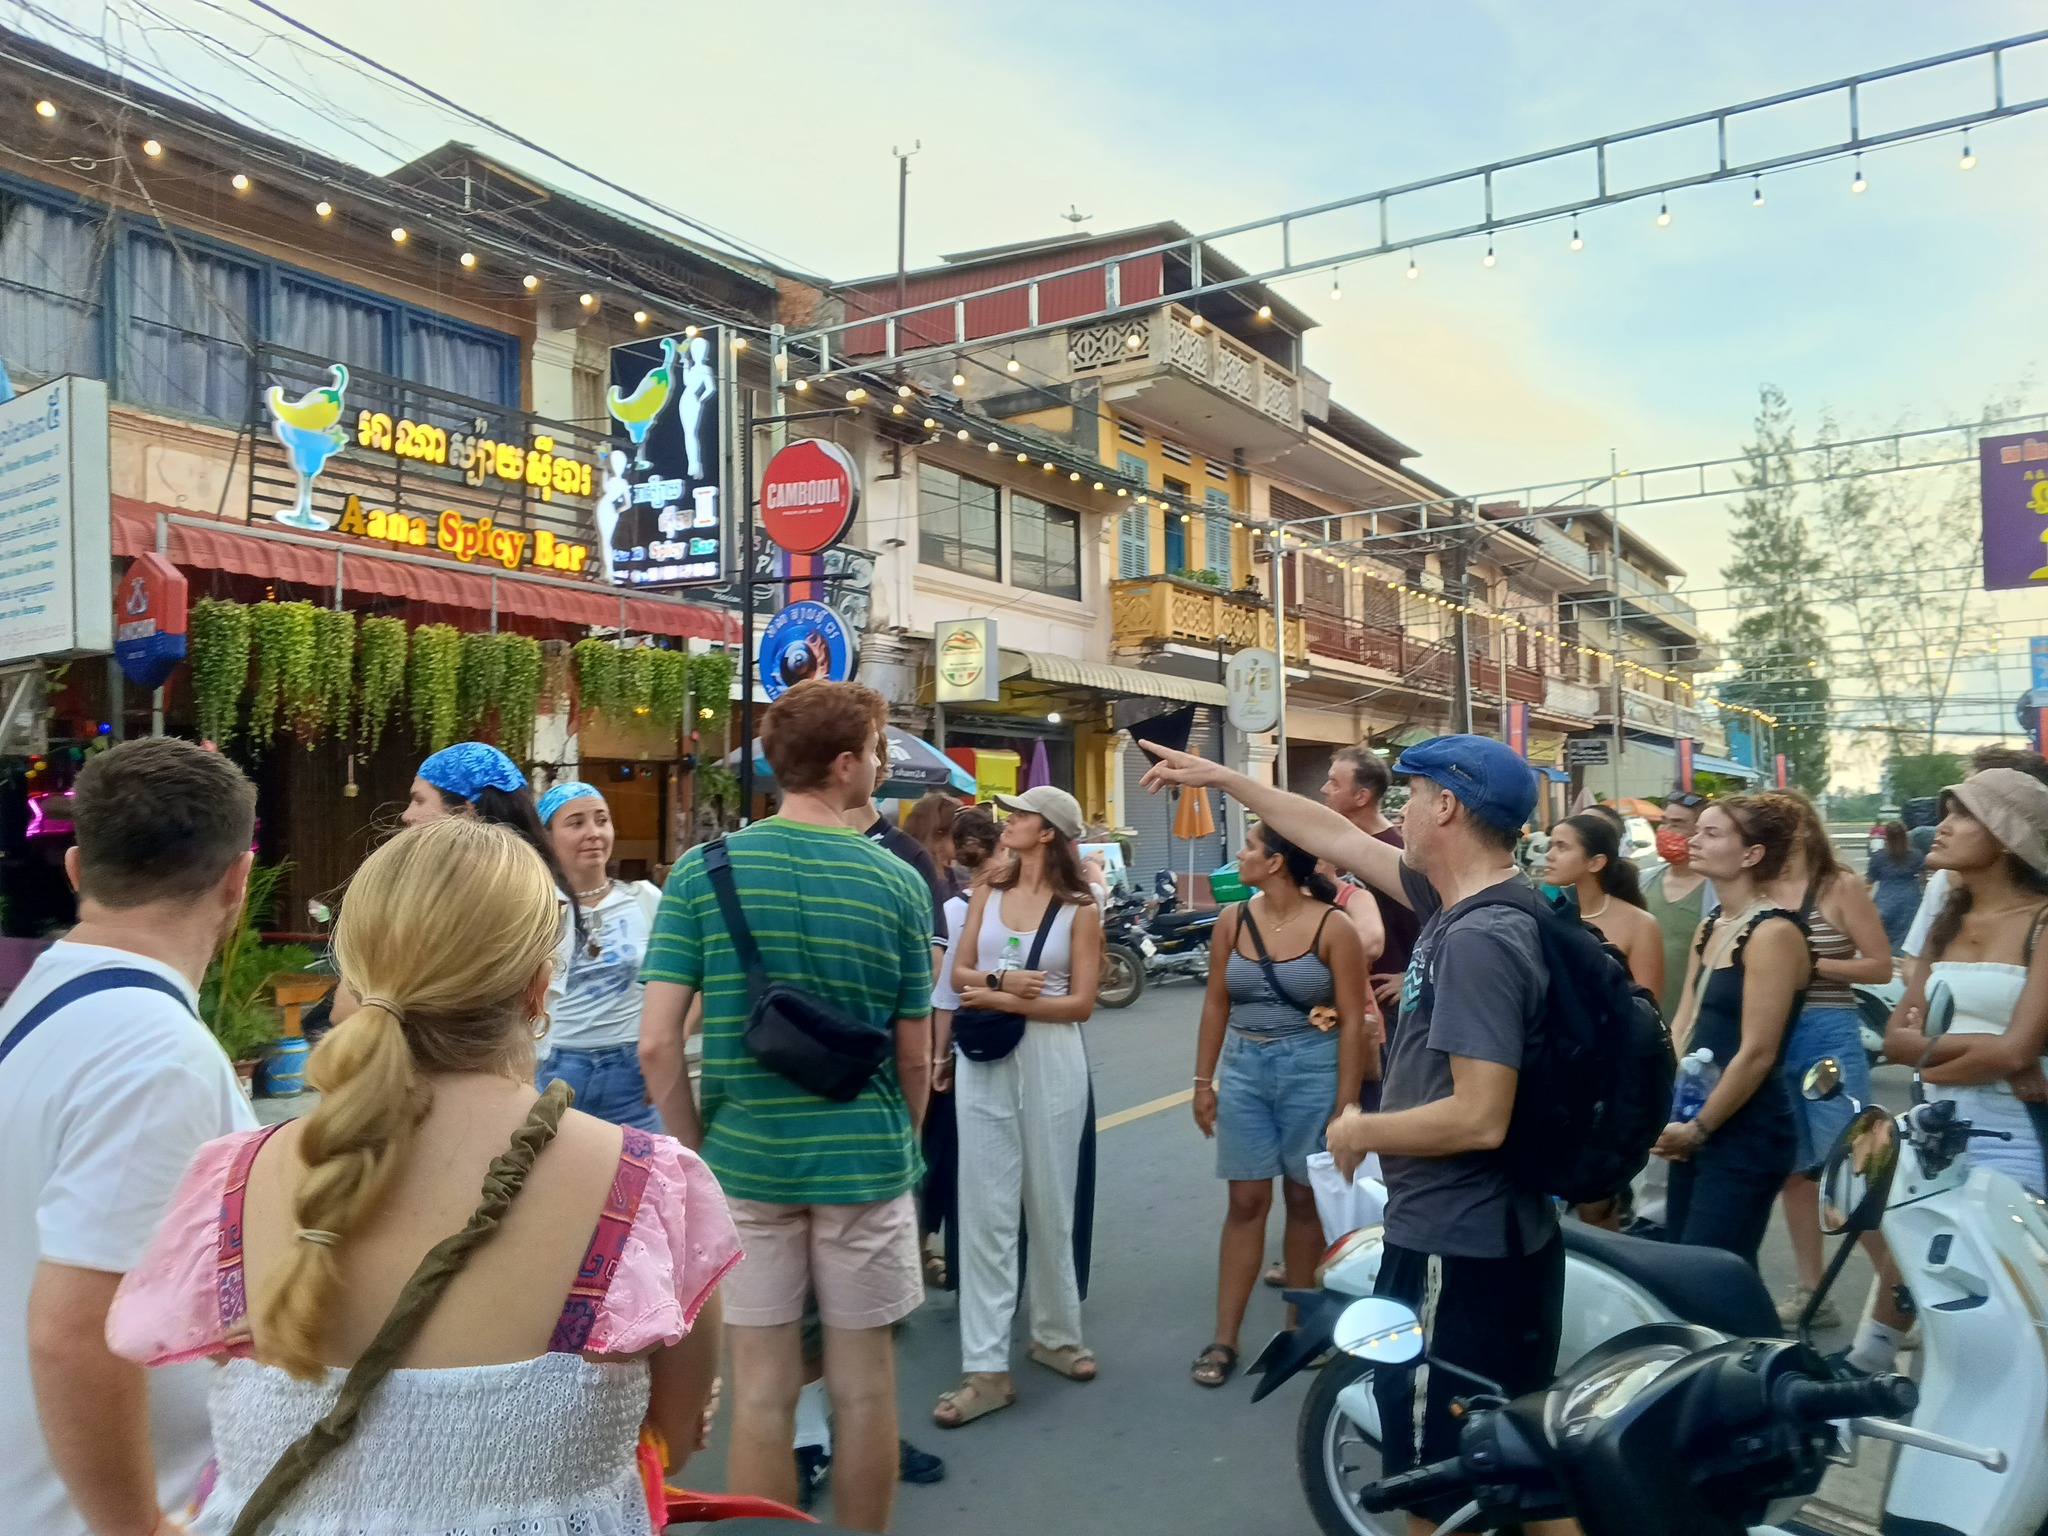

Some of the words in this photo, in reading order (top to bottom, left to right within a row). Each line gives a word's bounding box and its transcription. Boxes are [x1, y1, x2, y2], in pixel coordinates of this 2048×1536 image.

[767, 478, 840, 509] CAMBODIA
[340, 494, 428, 547] Aana
[437, 509, 526, 569] Spicy
[532, 529, 588, 572] Bar
